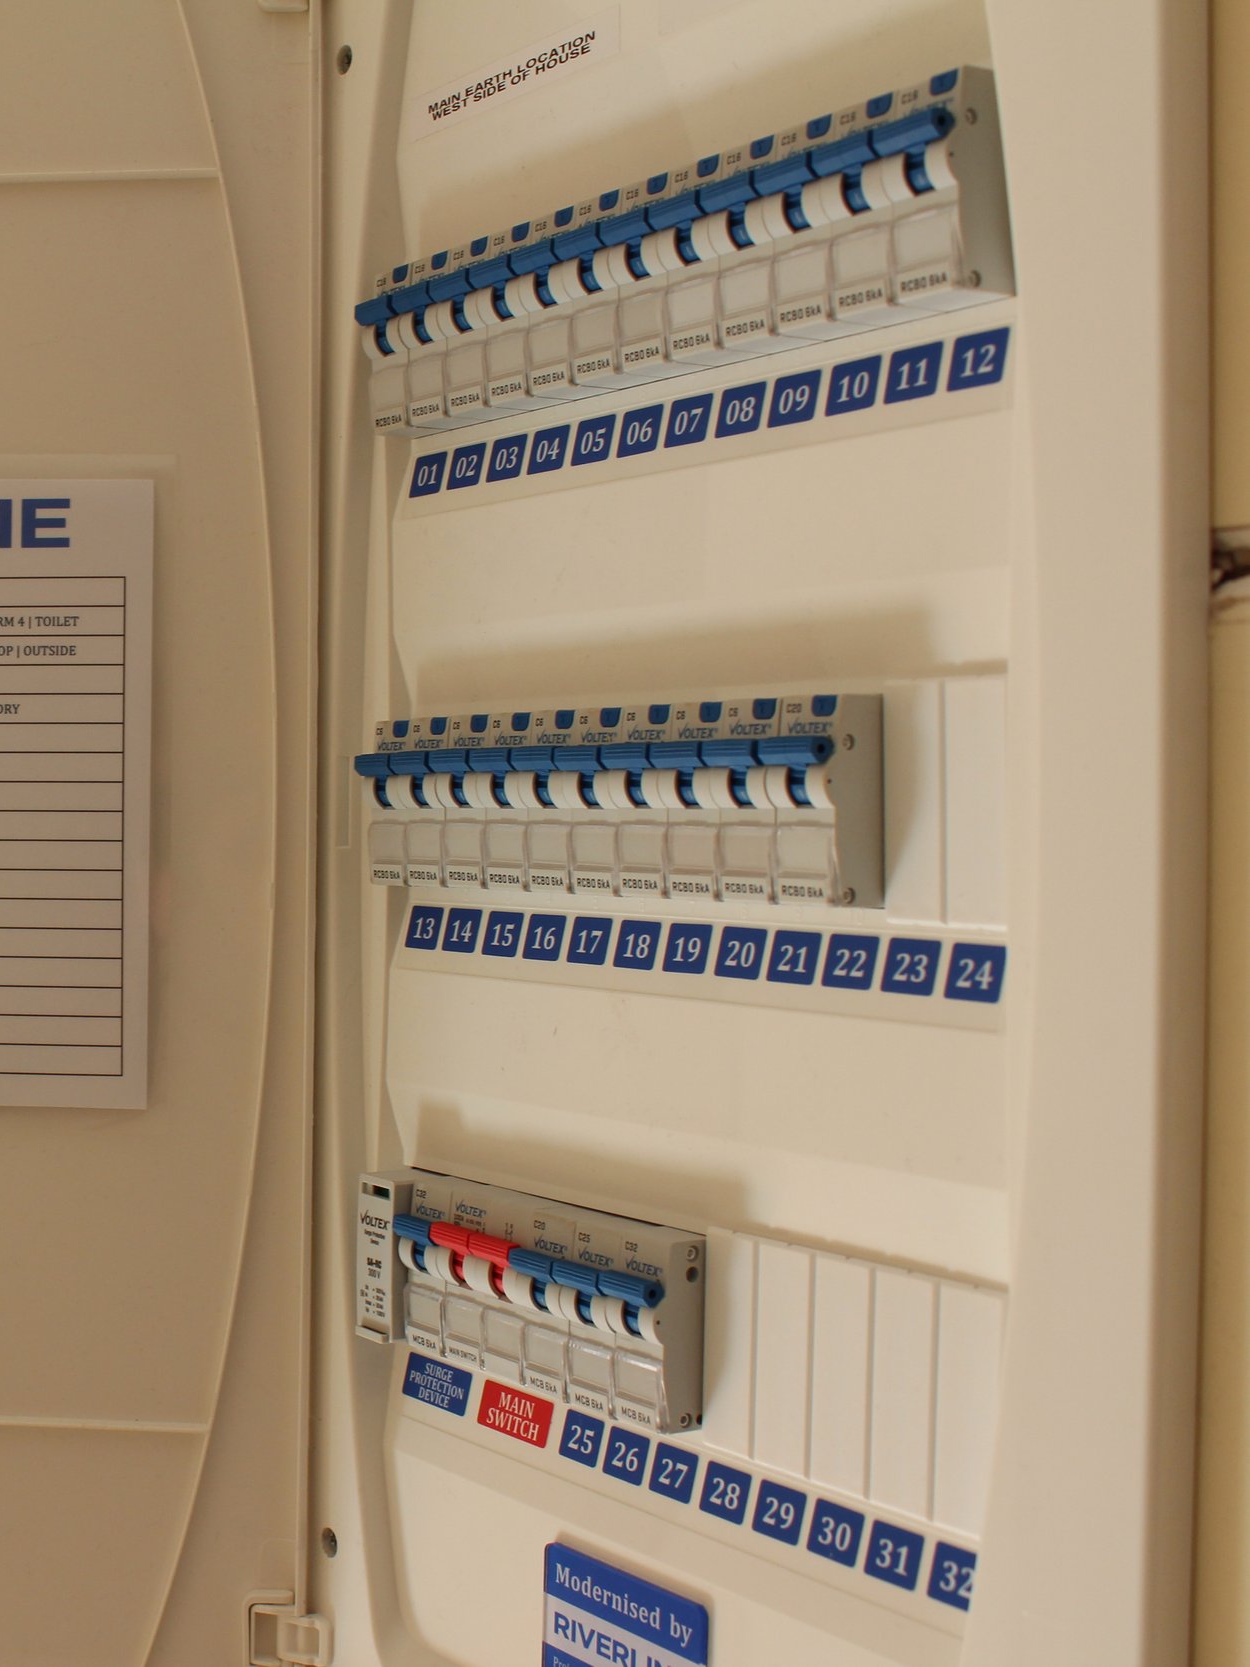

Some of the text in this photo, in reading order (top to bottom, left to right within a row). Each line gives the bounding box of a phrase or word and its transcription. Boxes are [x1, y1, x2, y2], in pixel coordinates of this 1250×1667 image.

[428, 30, 596, 114] MAIN EARTH LOCATION
[432, 43, 591, 121] WEST SIDE OF HOUSE
[897, 359, 927, 389] 11
[961, 345, 995, 376] 12
[779, 386, 810, 414] 09
[837, 372, 869, 402] 10
[674, 408, 703, 434] 07
[725, 397, 755, 424] 08
[580, 428, 606, 454] 05
[626, 419, 652, 445] 06
[495, 447, 518, 470] 03
[536, 438, 559, 462] 04
[417, 464, 437, 486] 01
[455, 455, 477, 478] 02
[17, 616, 25, 627] 4
[34, 615, 80, 627] TOILET
[23, 645, 77, 656] OUTSIDE
[413, 918, 434, 938] 13
[450, 920, 471, 942] 14
[490, 924, 514, 946] 15
[531, 927, 555, 949] 16
[576, 930, 602, 953] 17
[623, 934, 650, 958] 18
[672, 937, 701, 961] 19
[724, 941, 755, 967] 20
[777, 945, 807, 972] 21
[832, 949, 866, 977] 22
[892, 954, 928, 982] 23
[956, 959, 992, 989] 24
[409, 1370, 465, 1401] PROTECTION
[425, 1362, 454, 1383] SURGE
[418, 1386, 450, 1409] DEVICE
[498, 1391, 536, 1419] MAIN
[486, 1407, 540, 1441] SWITCH
[567, 1425, 594, 1454] 25
[611, 1442, 638, 1471] 26
[658, 1459, 688, 1488] 27
[709, 1478, 740, 1509] 28
[762, 1498, 794, 1528] 29
[818, 1517, 851, 1551] 30
[876, 1539, 908, 1575] 31
[939, 1562, 973, 1599] 32
[555, 1562, 693, 1648] Modernised by
